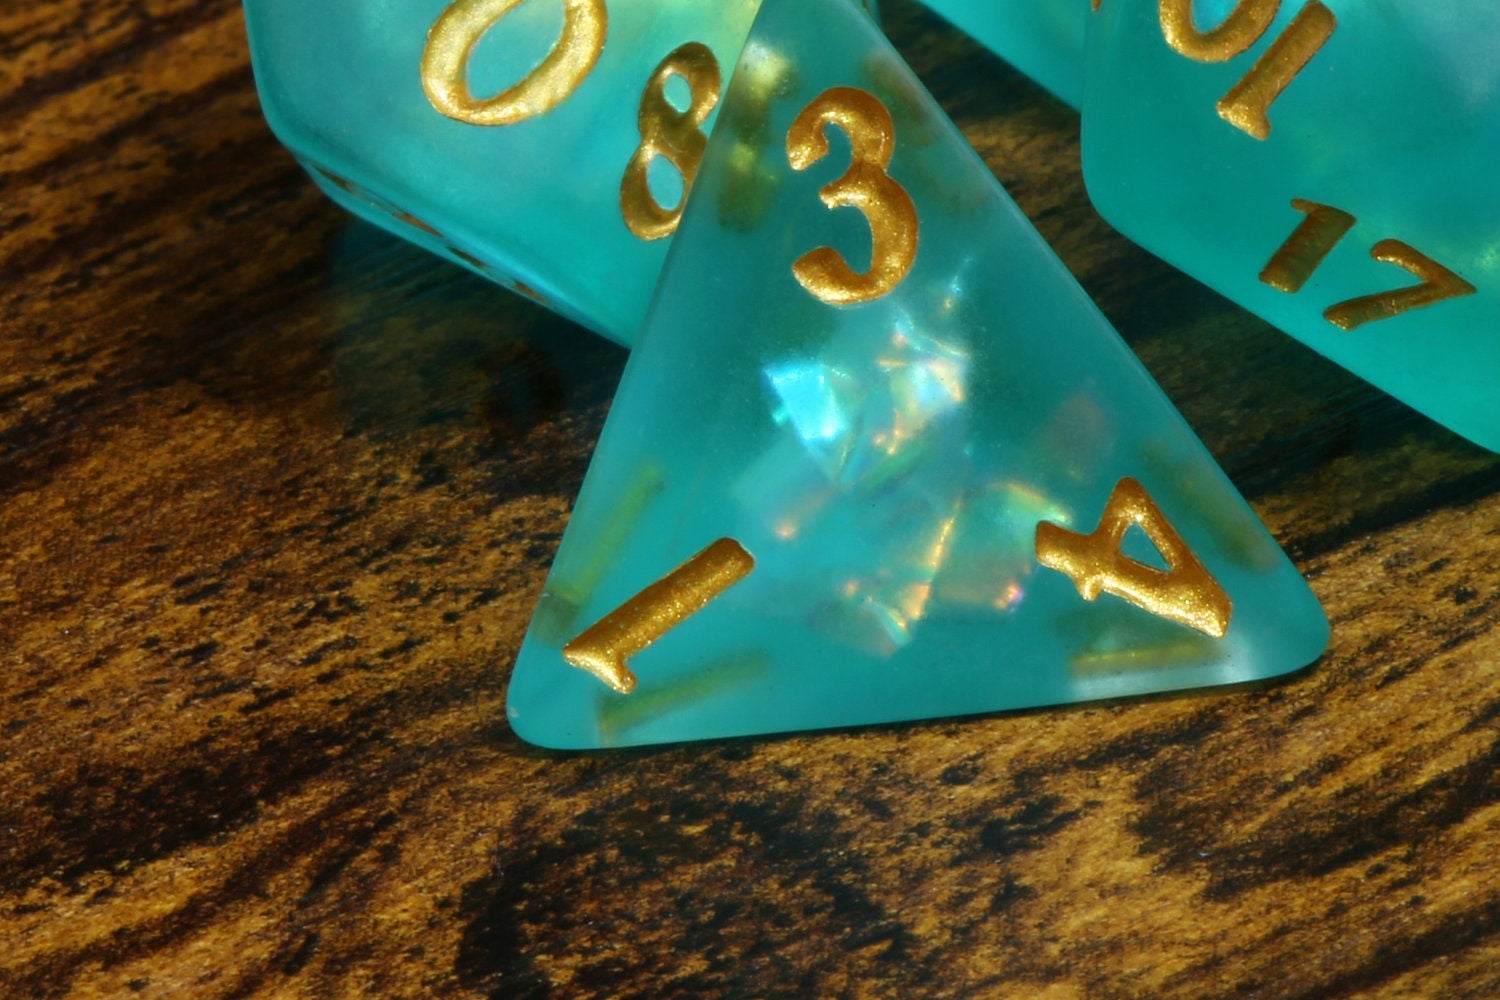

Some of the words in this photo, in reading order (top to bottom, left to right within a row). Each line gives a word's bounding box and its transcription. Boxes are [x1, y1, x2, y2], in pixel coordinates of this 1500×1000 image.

[786, 86, 919, 306] 3
[1258, 198, 1478, 332] 17
[562, 536, 756, 694] 1
[1034, 476, 1234, 638] 4
